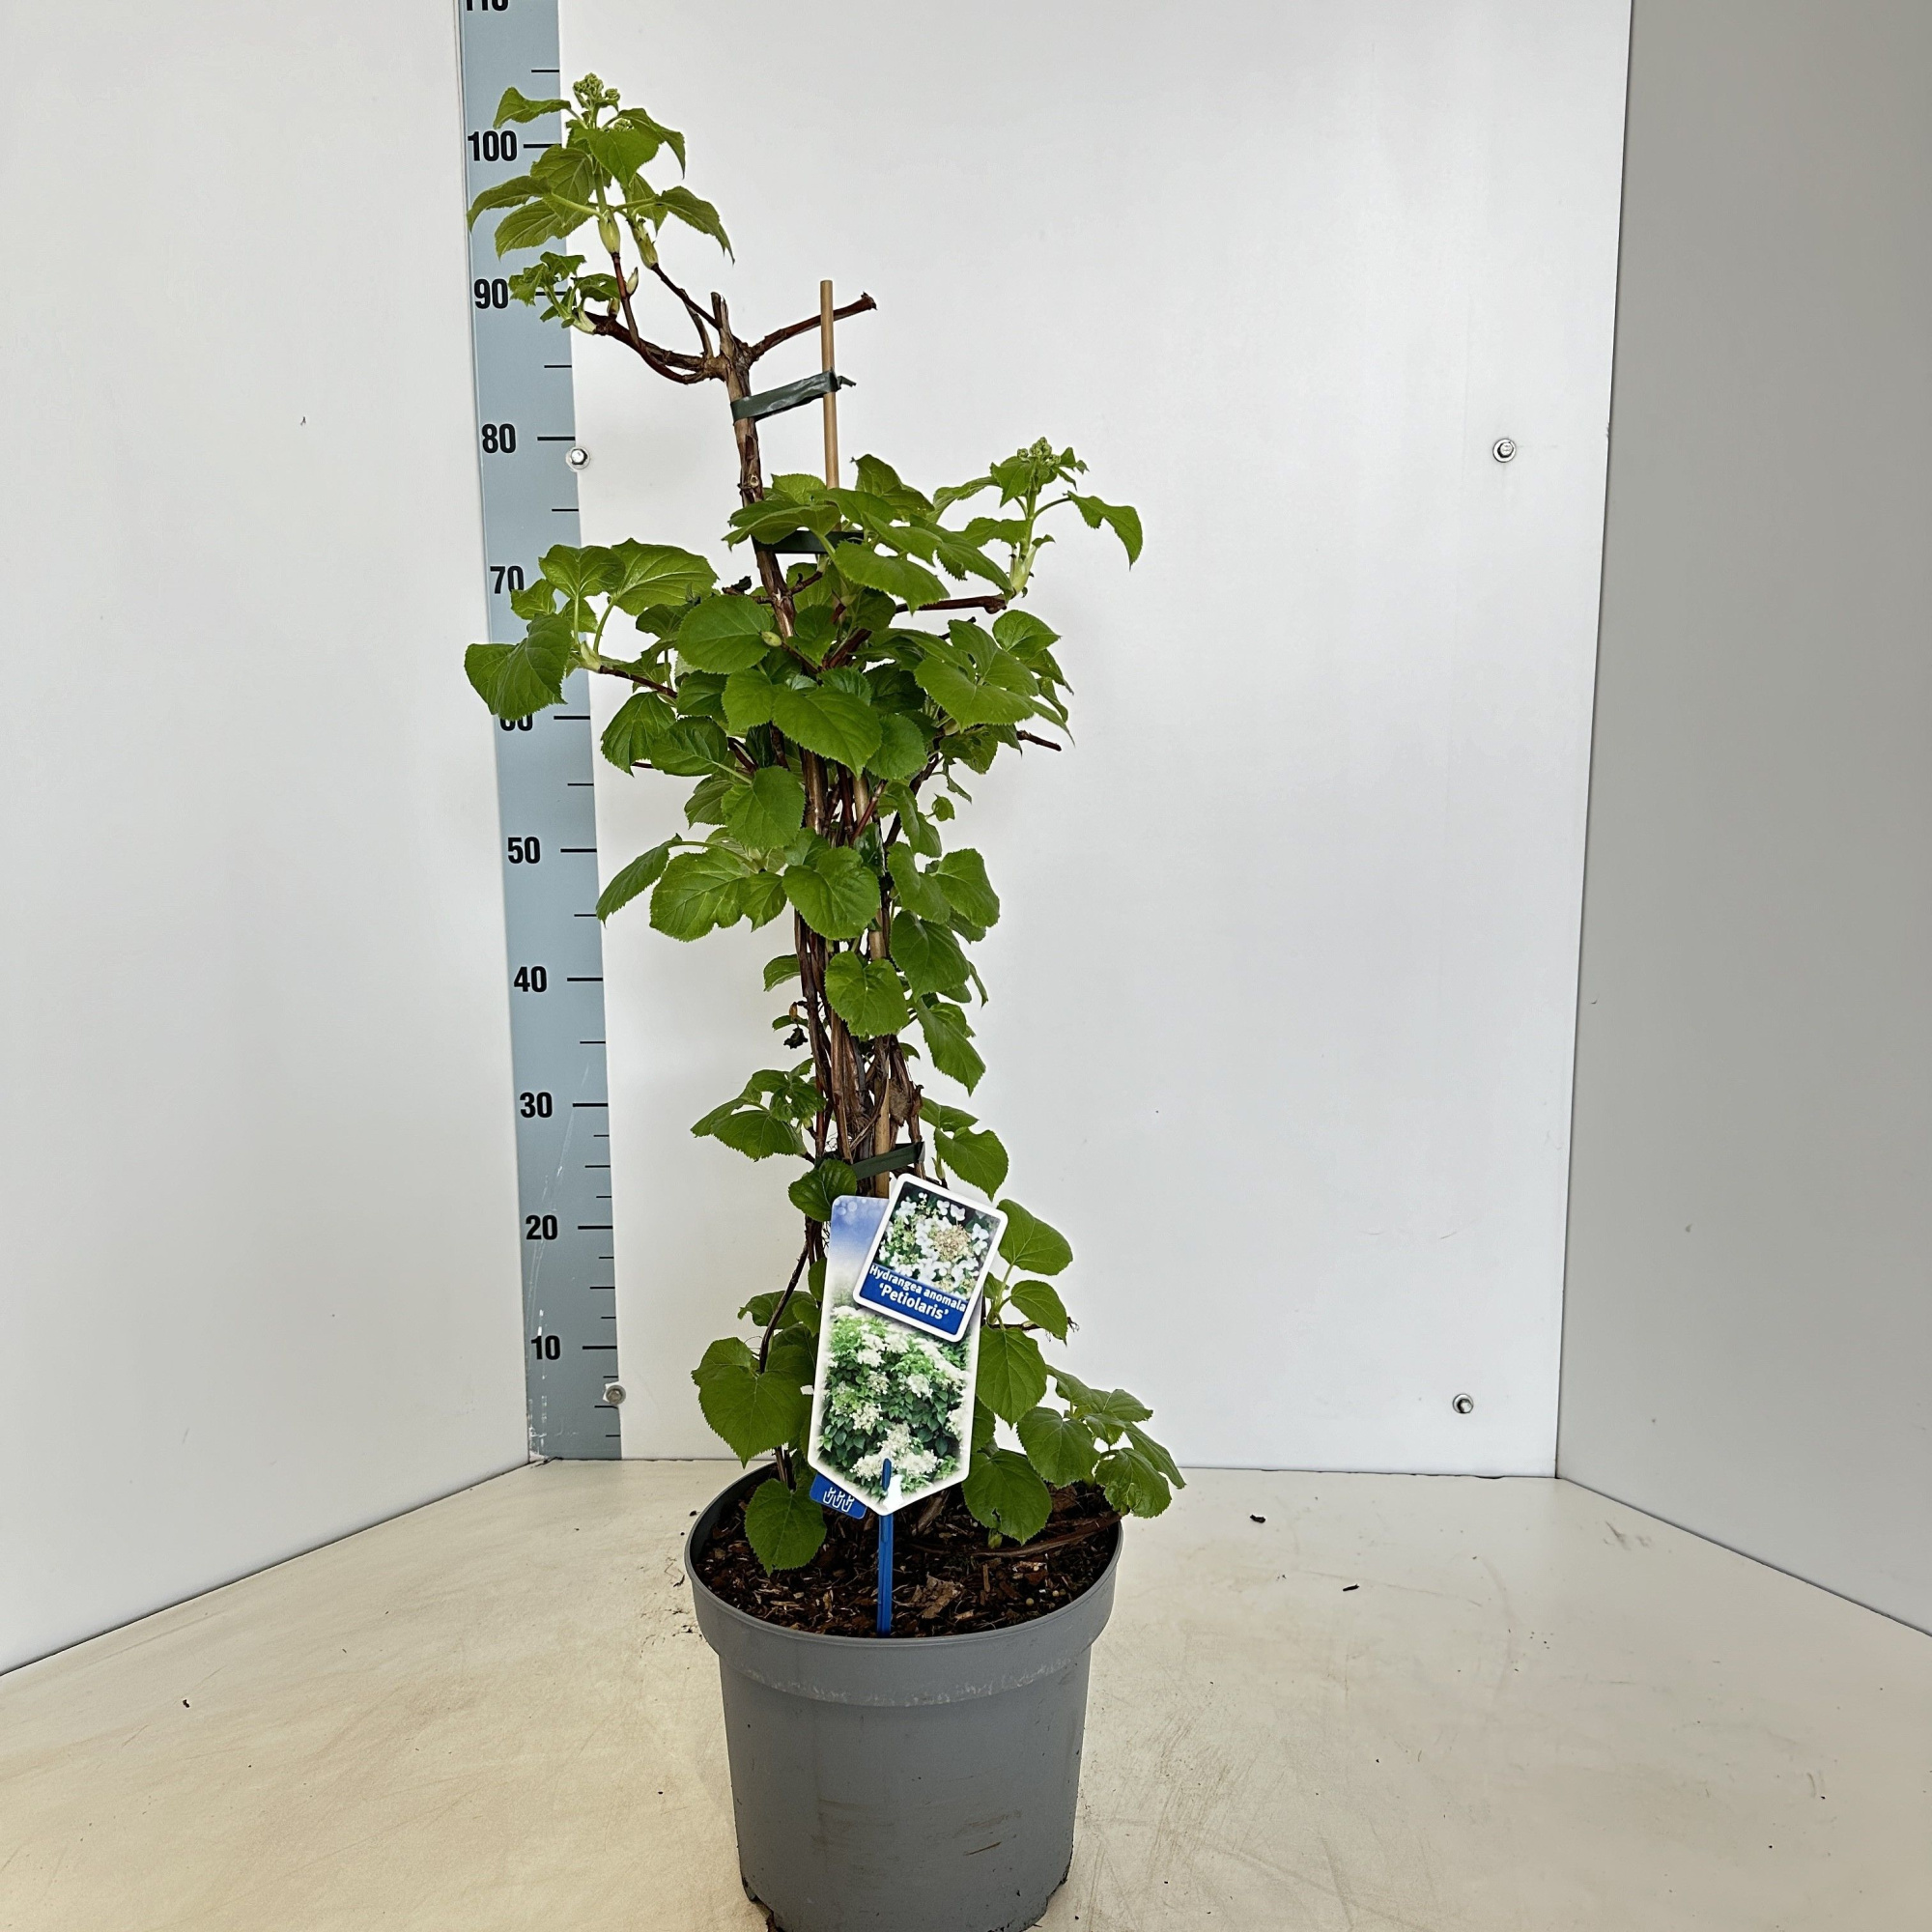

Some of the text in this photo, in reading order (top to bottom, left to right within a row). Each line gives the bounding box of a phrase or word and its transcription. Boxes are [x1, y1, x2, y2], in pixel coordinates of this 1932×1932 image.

[468, 130, 518, 161] 100
[474, 279, 509, 309] 90
[482, 423, 517, 453] 80
[490, 566, 525, 594] 70
[507, 837, 541, 864] 50
[514, 966, 547, 992] 40
[520, 1092, 553, 1118] 30
[526, 1214, 558, 1240] 20
[869, 1264, 966, 1312] Hydrangea anomala
[530, 1335, 561, 1360] 10
